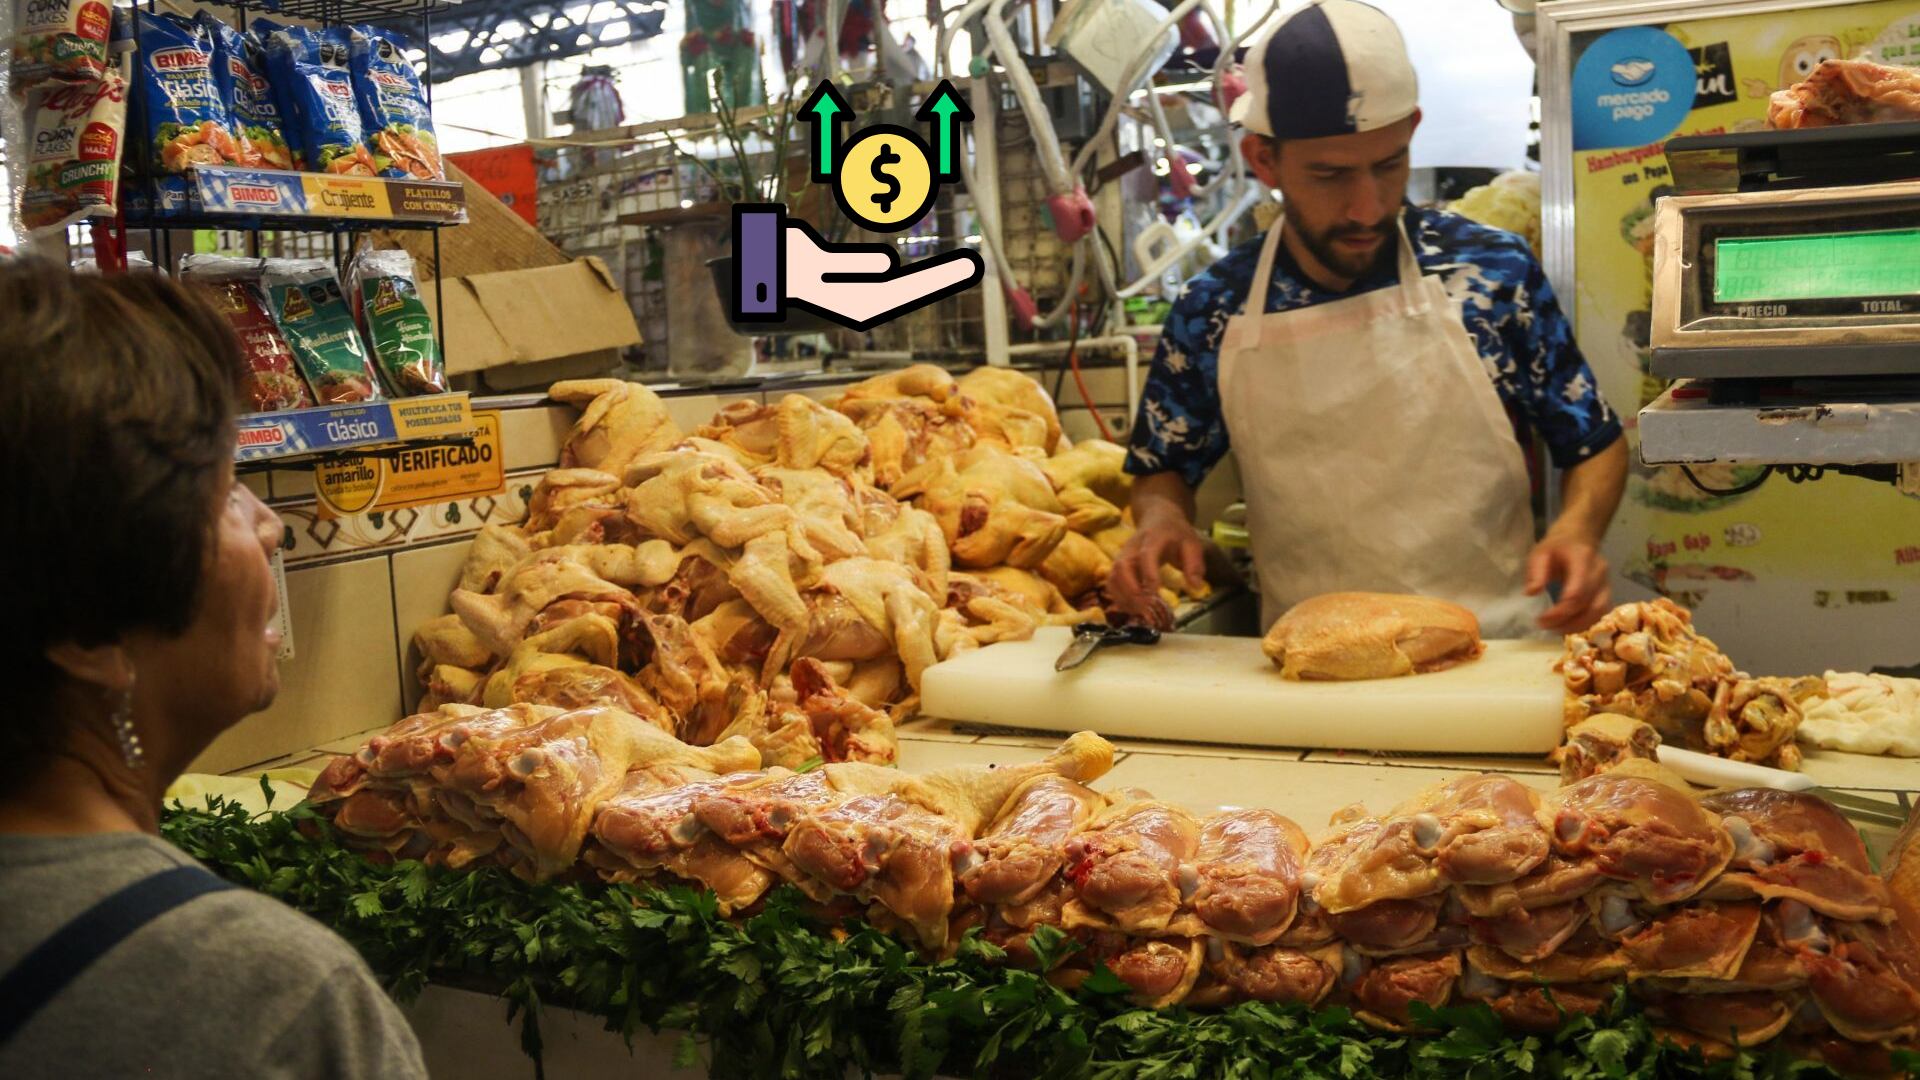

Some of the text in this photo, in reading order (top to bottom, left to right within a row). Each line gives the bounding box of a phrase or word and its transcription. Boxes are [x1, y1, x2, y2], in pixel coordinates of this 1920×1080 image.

[1597, 89, 1670, 107] mercado
[1613, 105, 1654, 121] pago
[37, 127, 77, 144] CORN
[61, 163, 110, 185] CRUNCHY
[231, 187, 278, 202] BIMBO
[321, 189, 375, 210] Crujiente
[404, 187, 452, 200] PLATILLOS
[403, 201, 458, 213] CON CRUNCH
[1738, 304, 1787, 317] PRECIO
[1861, 300, 1903, 313] TOTAL
[399, 403, 462, 416] MULTIPLICA TUS
[327, 418, 378, 441] Clásico
[405, 415, 462, 428] POSIBILIDADES
[238, 428, 282, 444] BIMBO
[391, 444, 492, 474] VERIFICADO
[325, 467, 375, 485] amarillo
